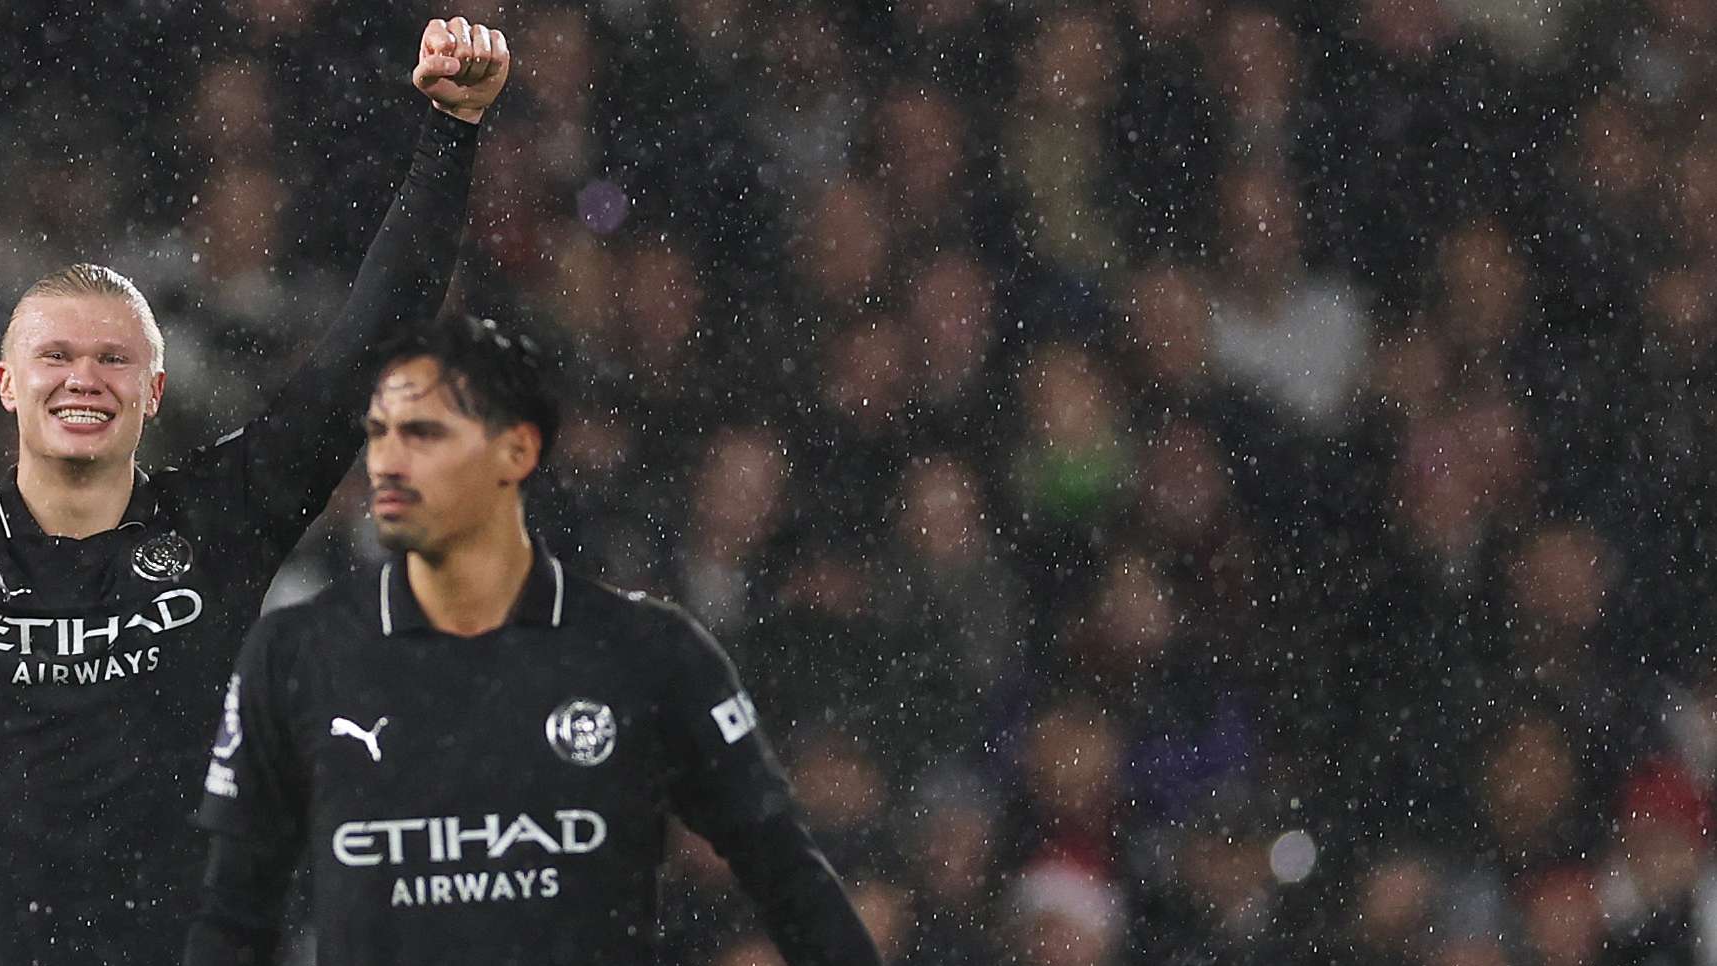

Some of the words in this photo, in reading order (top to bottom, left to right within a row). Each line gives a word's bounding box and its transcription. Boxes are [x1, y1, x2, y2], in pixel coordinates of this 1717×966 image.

[11, 646, 160, 685] AIRWAYS
[332, 808, 608, 867] ETIHAD
[390, 868, 560, 907] AIRWAYS
